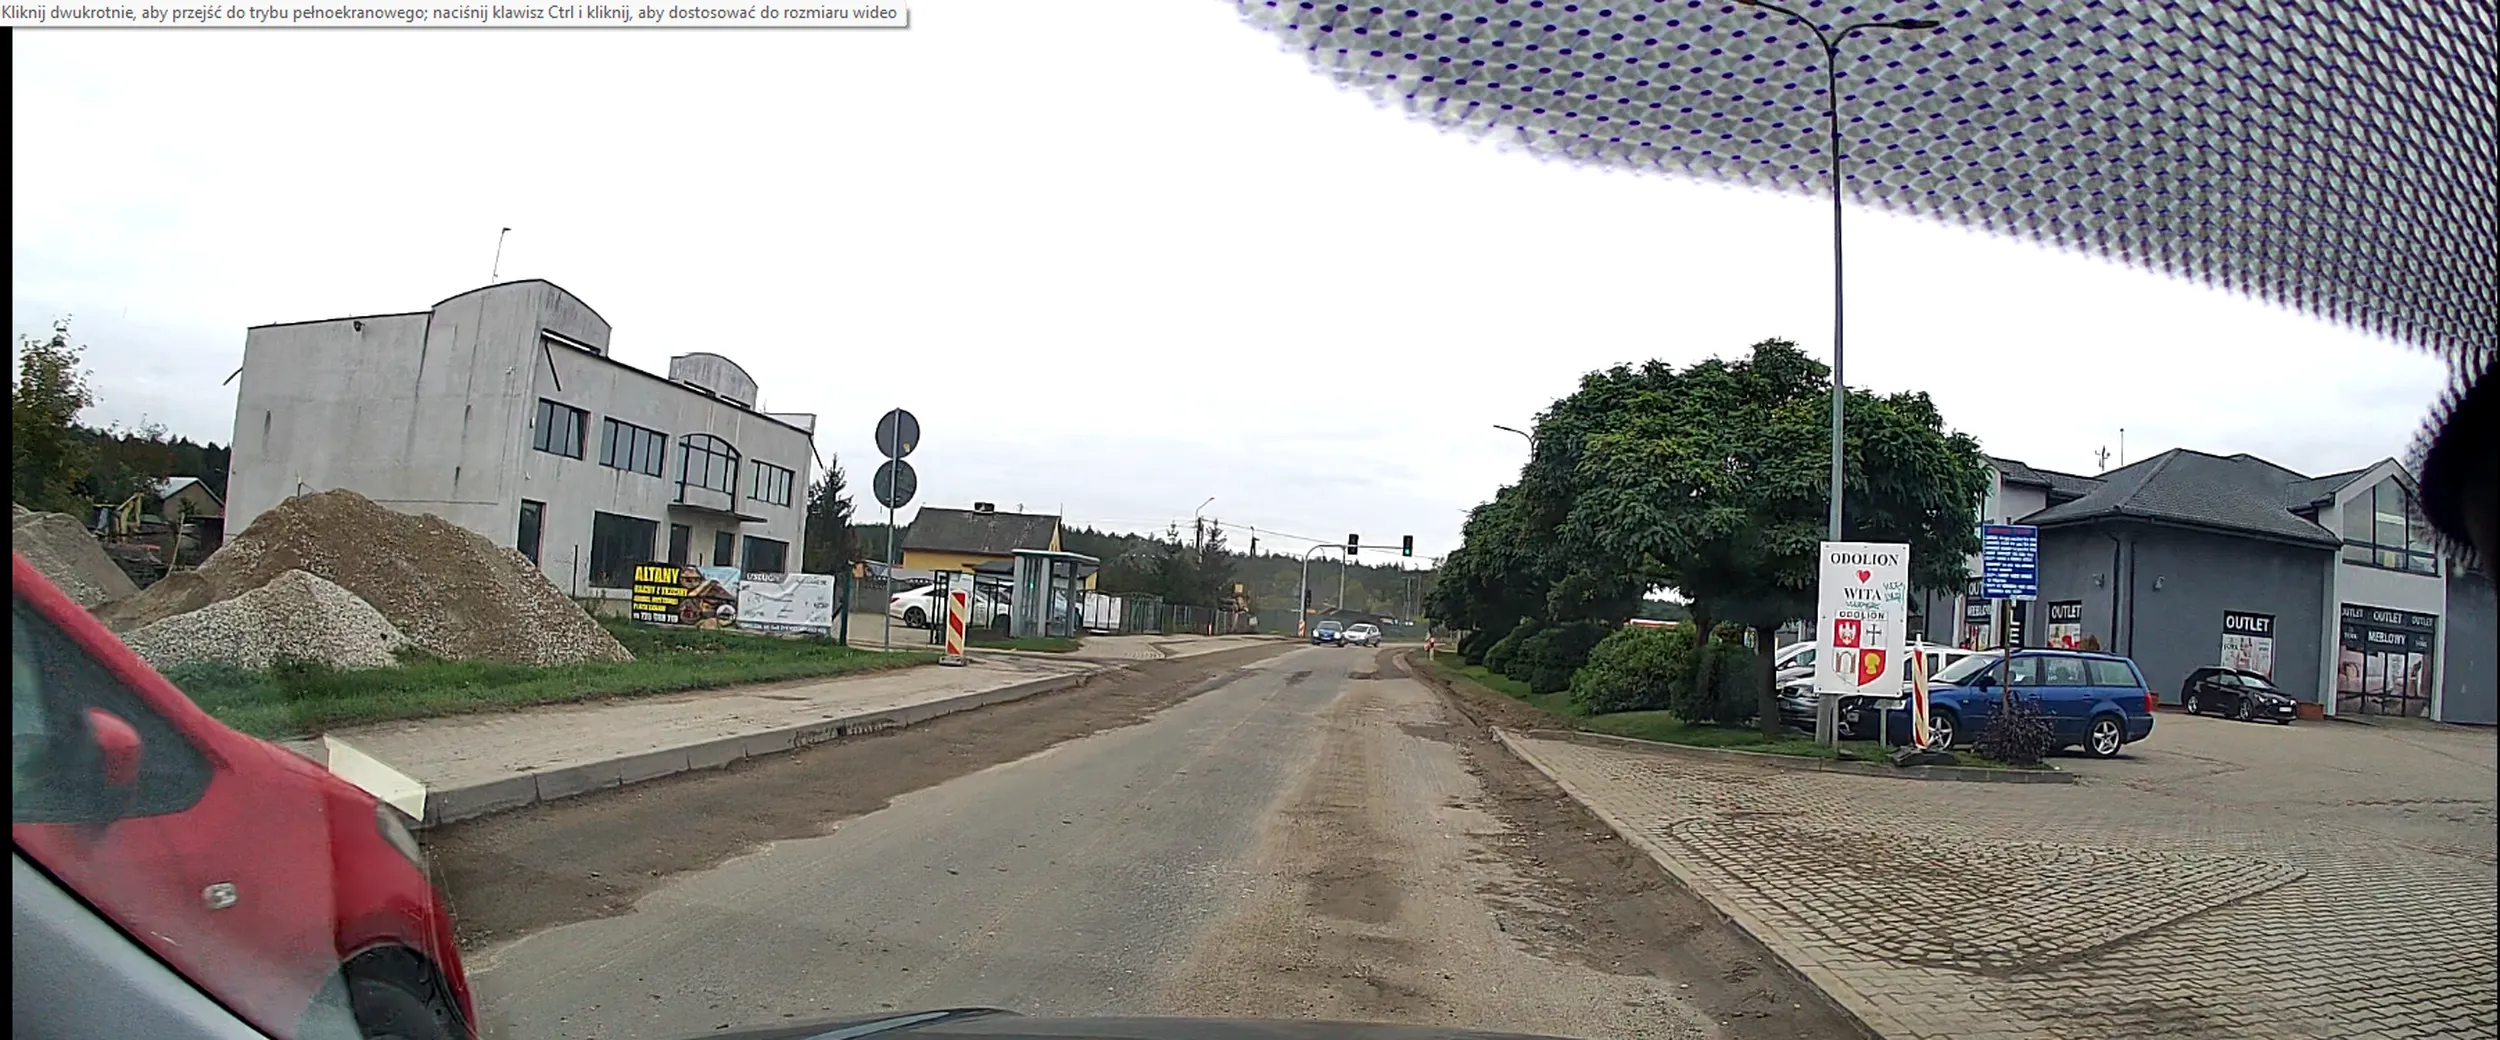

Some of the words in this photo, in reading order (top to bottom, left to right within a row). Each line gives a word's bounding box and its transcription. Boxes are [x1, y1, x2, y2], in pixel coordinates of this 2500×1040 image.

[1830, 552, 1899, 567] ODOLION
[634, 565, 680, 584] ALTANY
[1844, 587, 1882, 601] WITA
[1839, 610, 1885, 620] ODOLION
[2051, 605, 2082, 619] OUTLET
[2373, 611, 2402, 624] OUTLET
[2226, 615, 2269, 632] OUTLET
[2367, 630, 2406, 645] MEBLOWY
